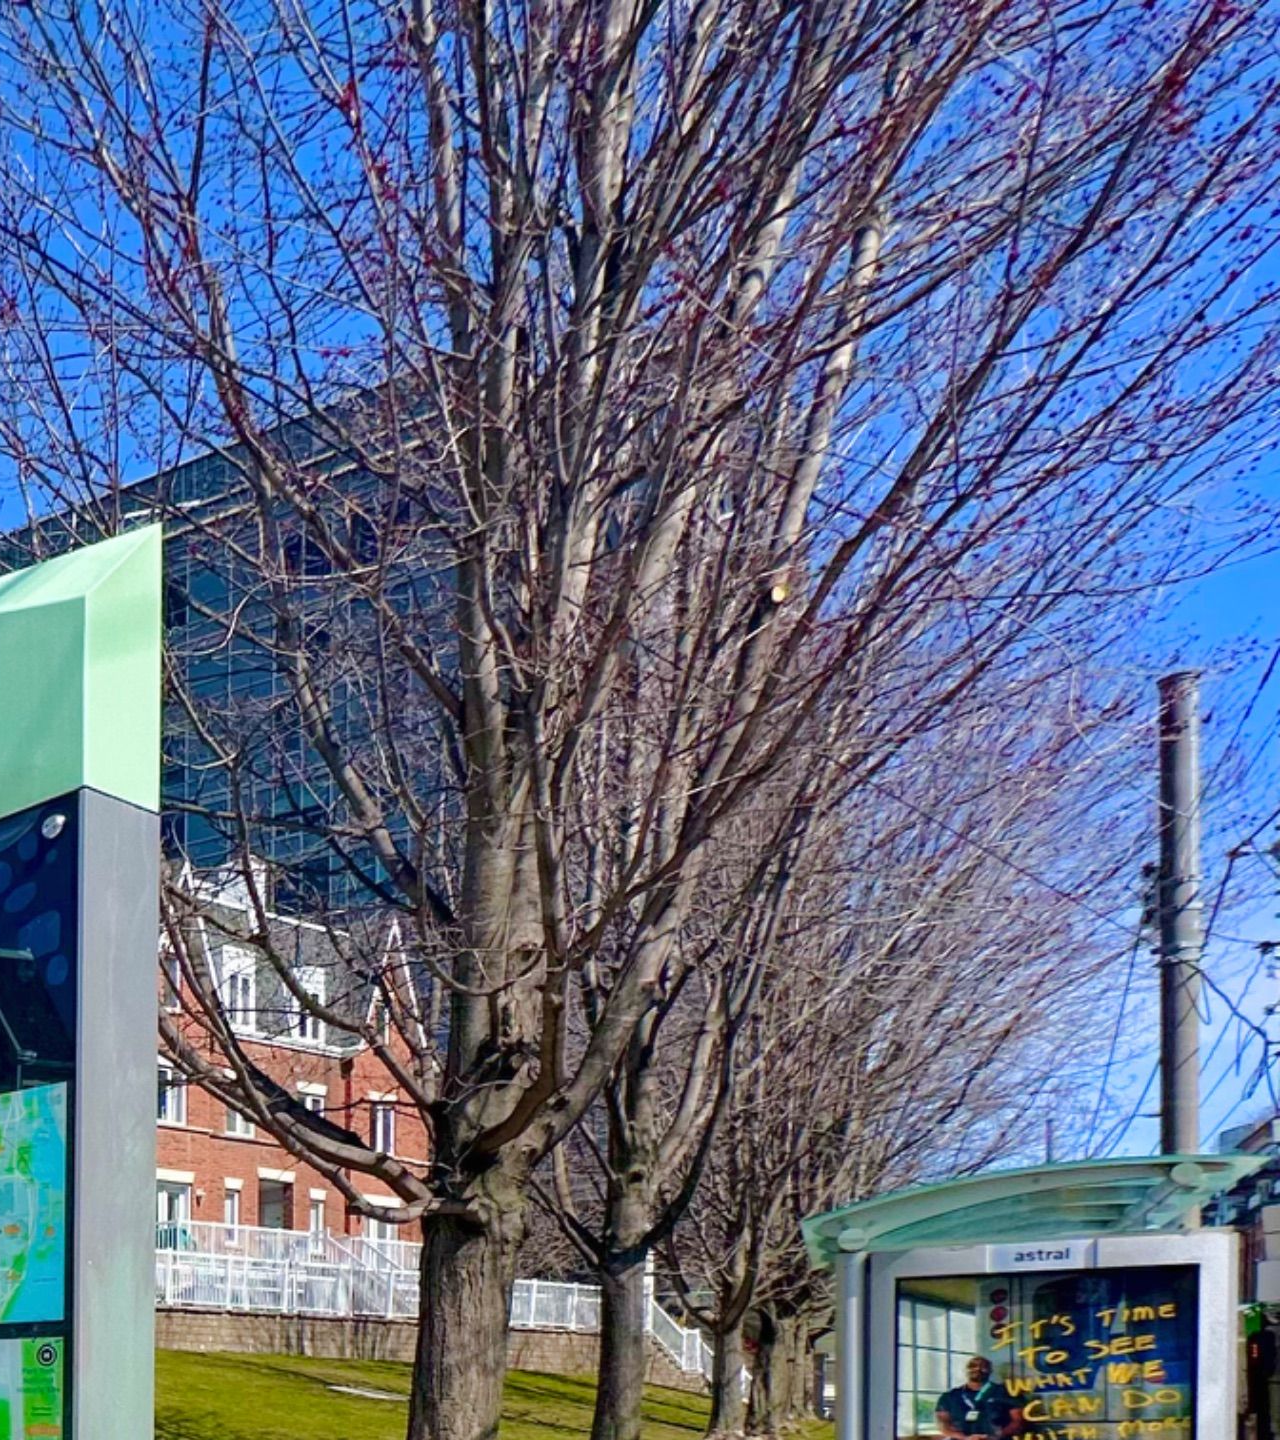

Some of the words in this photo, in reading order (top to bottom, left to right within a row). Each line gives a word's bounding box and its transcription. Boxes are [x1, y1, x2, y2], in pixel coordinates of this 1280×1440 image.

[1014, 1248, 1071, 1262] astral
[991, 1315, 1076, 1350] IT'S
[1096, 1304, 1177, 1327] TIME
[1018, 1347, 1069, 1368] TO
[1084, 1335, 1157, 1359] SEE
[1005, 1369, 1092, 1397] WHAT
[1107, 1359, 1166, 1384] WE
[1023, 1396, 1101, 1421] CAN
[1122, 1389, 1181, 1408] DO
